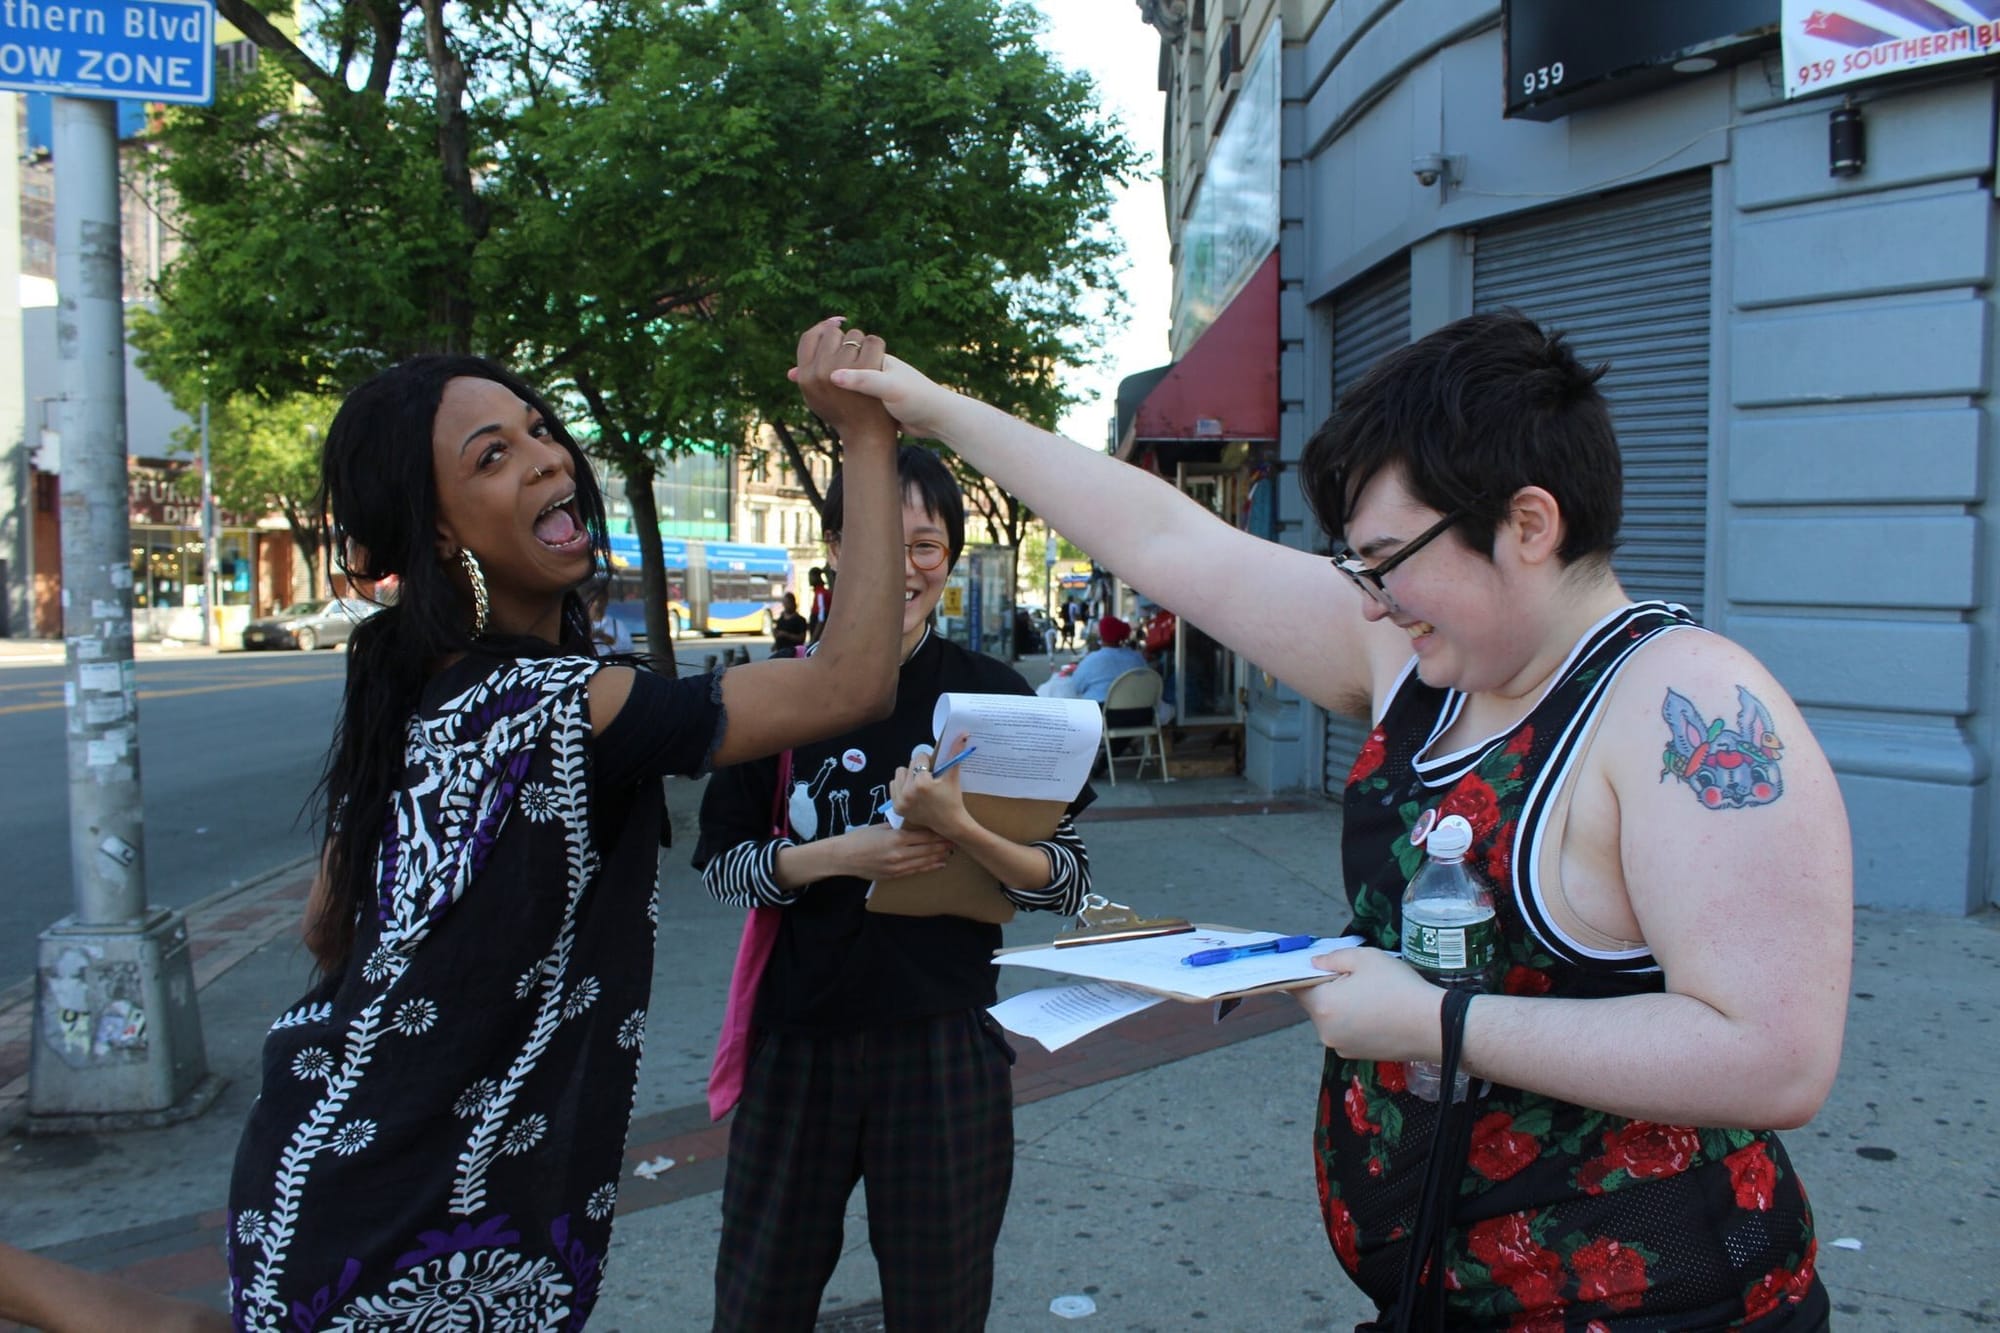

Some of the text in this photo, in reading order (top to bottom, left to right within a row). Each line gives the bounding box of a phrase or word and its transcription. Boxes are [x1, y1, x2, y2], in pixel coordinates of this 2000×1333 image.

[124, 7, 201, 43] Blvd
[77, 50, 192, 88] ZONE
[1798, 59, 1836, 86] 939
[1843, 28, 1968, 73] SOUTHERN
[1523, 62, 1564, 95] 939
